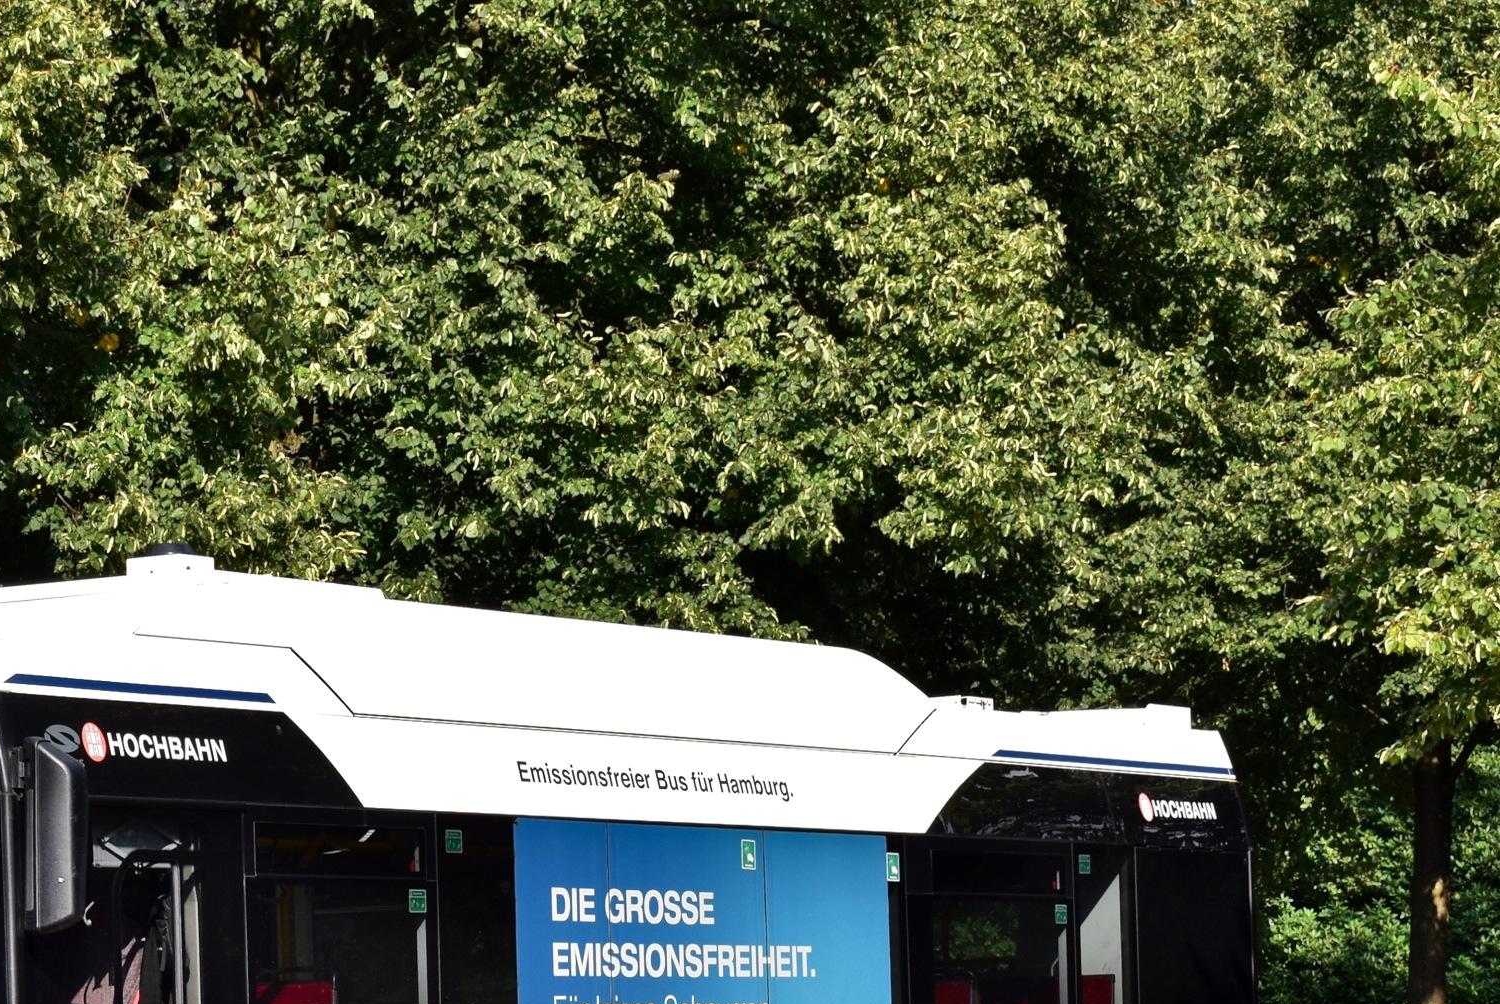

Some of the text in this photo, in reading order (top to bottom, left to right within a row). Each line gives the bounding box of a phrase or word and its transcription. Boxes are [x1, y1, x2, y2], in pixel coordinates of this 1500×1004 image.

[107, 732, 228, 763] HOCHBAHN
[516, 760, 795, 802] Emissionsfreier Bus für Hamburg.
[1152, 799, 1217, 820] HOCHBAHN
[551, 887, 715, 925] DIE GROSSE
[552, 942, 817, 978] EMISSIONSFREIHEIT.
